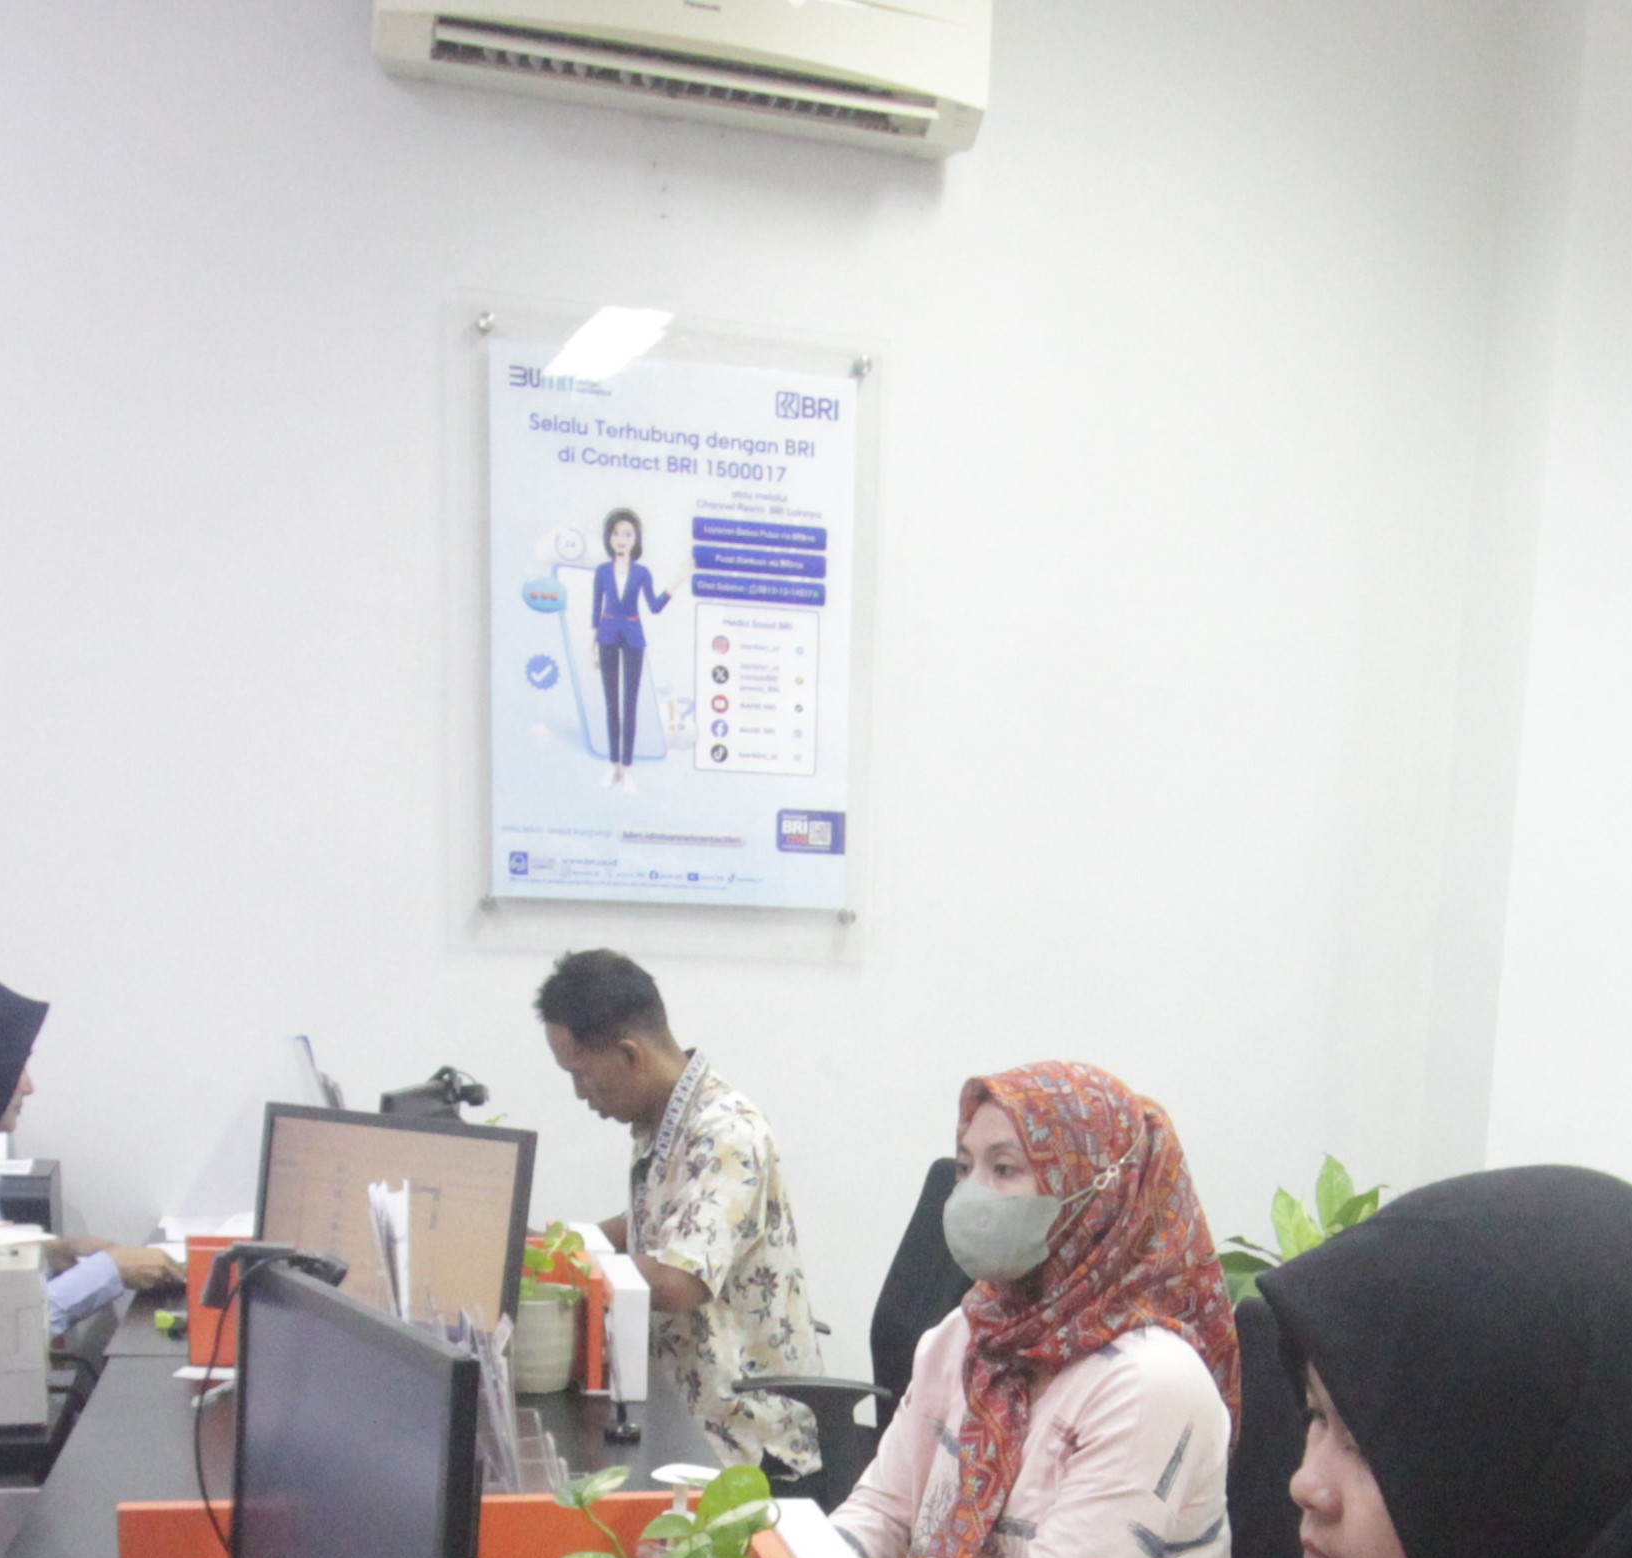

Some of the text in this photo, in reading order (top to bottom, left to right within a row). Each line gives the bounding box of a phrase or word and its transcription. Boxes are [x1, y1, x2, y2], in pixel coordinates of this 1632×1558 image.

[802, 396, 840, 421] BRI
[529, 413, 815, 458] Selalu Terhubung dengan BRI
[558, 446, 787, 483] di Contact BRI 1500017
[782, 820, 808, 835] BRI
